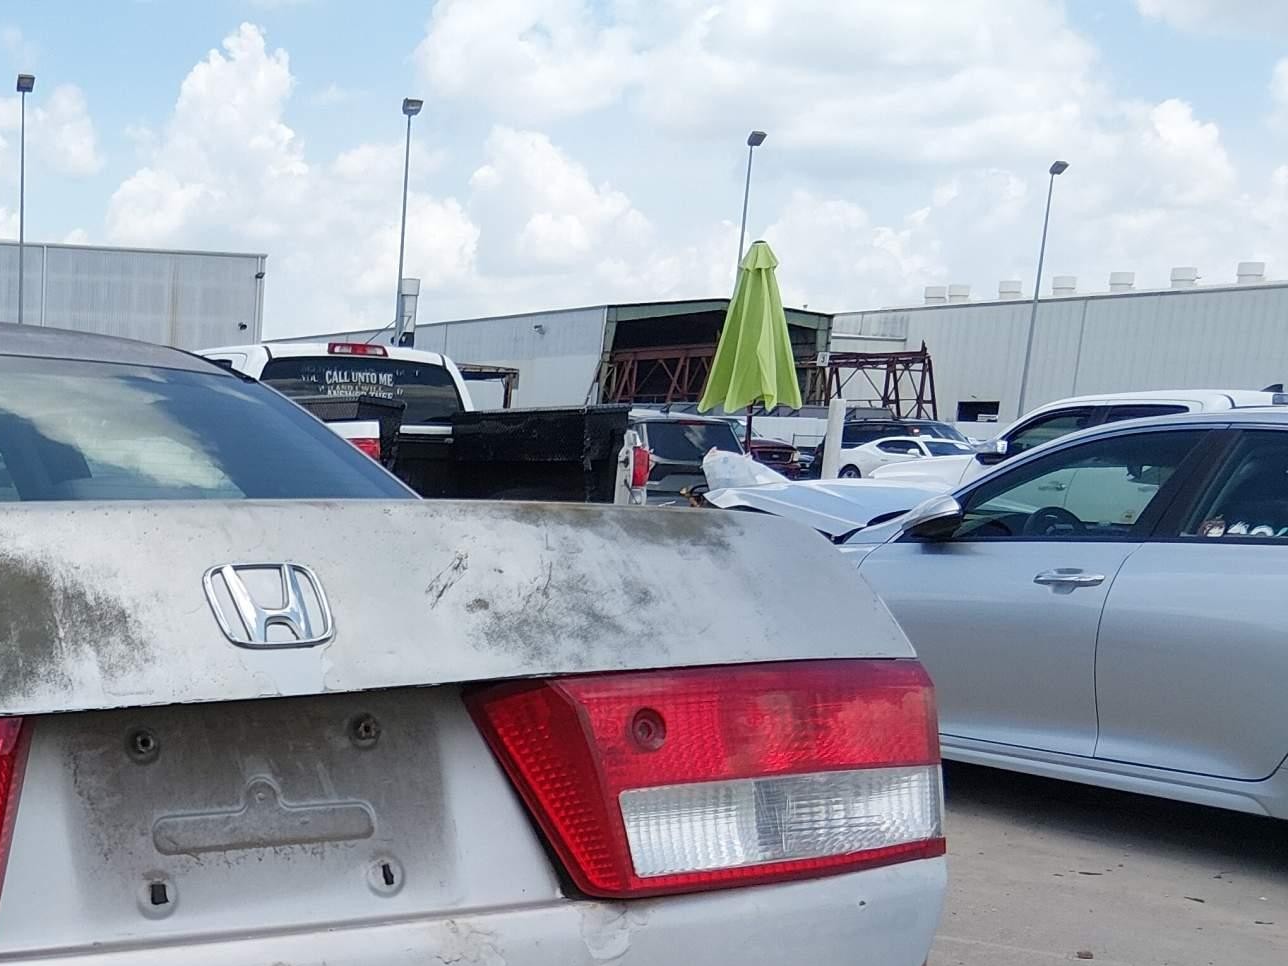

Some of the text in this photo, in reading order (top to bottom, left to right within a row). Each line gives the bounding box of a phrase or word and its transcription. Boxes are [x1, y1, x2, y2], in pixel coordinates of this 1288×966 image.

[325, 370, 350, 384] CALL
[352, 372, 376, 384] UNTO
[378, 373, 393, 386] ME
